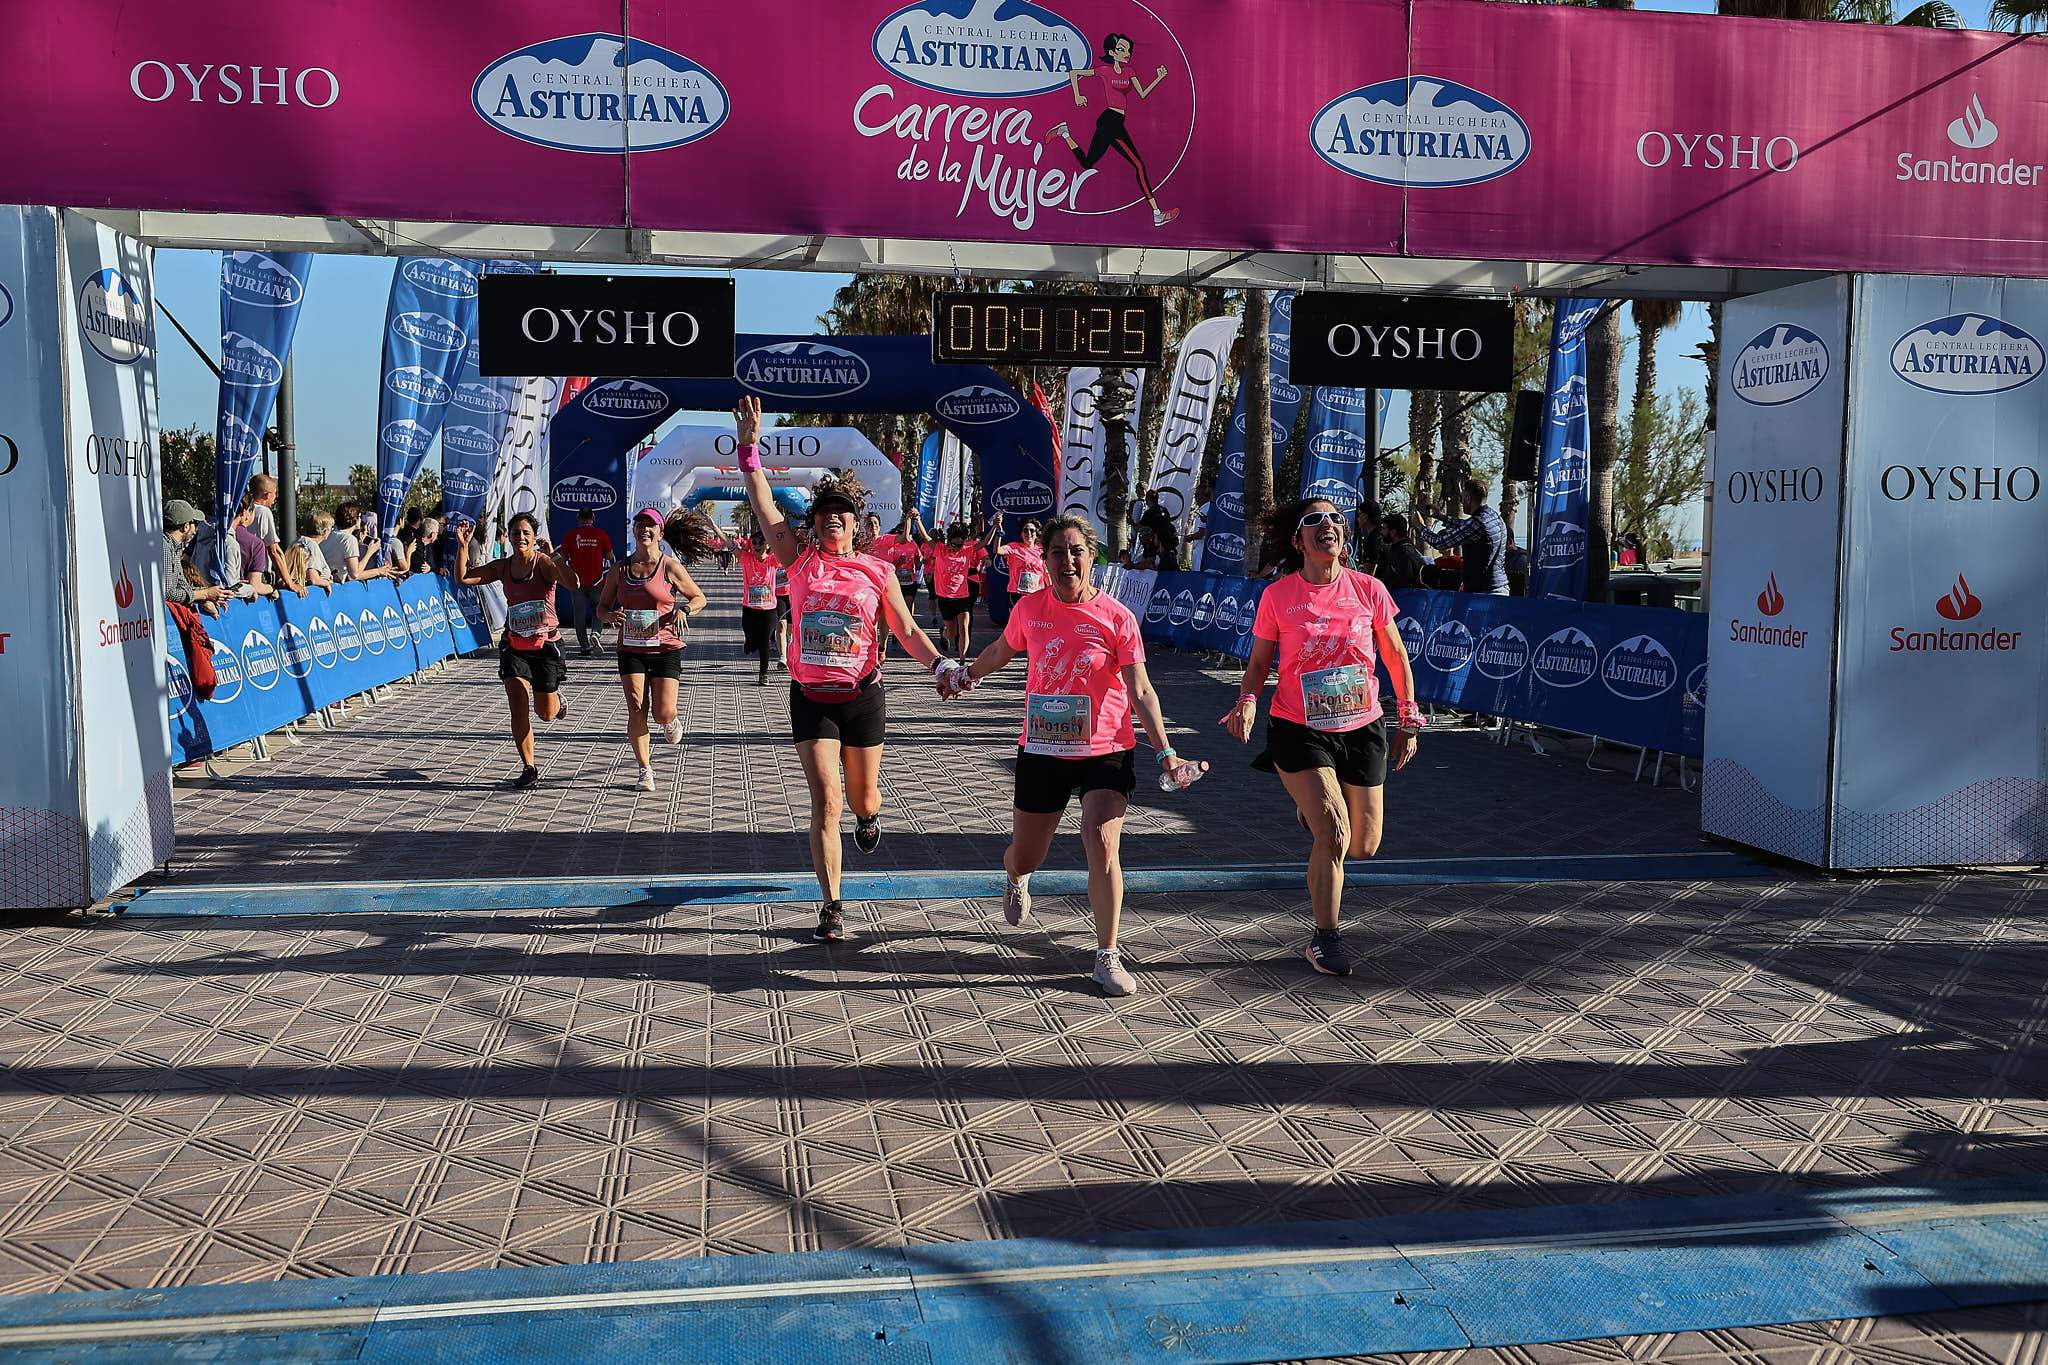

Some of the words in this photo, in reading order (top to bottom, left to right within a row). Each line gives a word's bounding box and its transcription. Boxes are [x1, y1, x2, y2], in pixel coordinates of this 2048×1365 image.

[924, 24, 993, 38] CENTRAL
[999, 26, 1069, 42] LECHERA
[890, 24, 1073, 73] ASTURIANA
[130, 60, 340, 109] OYSHO
[532, 72, 613, 87] CENTRAL
[492, 73, 710, 124] ASTURIANA
[853, 84, 1033, 145] Carrera
[1362, 112, 1431, 125] CENTRAL
[1438, 115, 1507, 129] LECHERA
[1327, 113, 1514, 161] ASTURIANA
[1636, 131, 1799, 173] OYSHO
[1896, 152, 2042, 188] Santander
[897, 143, 931, 181] de
[938, 145, 962, 183] la
[956, 142, 1099, 230] Mujer
[408, 264, 475, 295] ASTURIANA
[85, 294, 145, 346] ASTURIANA
[521, 307, 700, 347] OYSHO
[950, 305, 1145, 354] 00:41:25
[1327, 323, 1483, 361] OYSHO
[1751, 352, 1782, 364] CENTRAL
[1784, 346, 1819, 360] LECHERA
[1926, 341, 1975, 350] CENTRAL
[1979, 342, 2030, 351] LECHERA
[744, 358, 861, 385] ASTURIANA
[765, 357, 809, 365] CENTRAL
[812, 358, 856, 366] LECHERA
[1900, 342, 2033, 375] ASTURIANA
[1737, 359, 1821, 390] ASTURIANA
[587, 395, 663, 409] ASTURIANA
[942, 401, 1015, 415] ASTURIANA
[1321, 388, 1365, 408] ASTURIA
[86, 434, 152, 479] OYSHO
[511, 377, 538, 516] OYSH
[714, 434, 821, 457] OSHO
[650, 458, 683, 466] OYSHO
[850, 457, 882, 466] OYSHO
[442, 479, 485, 493] STURIANA
[554, 488, 613, 504] ASTURIANA
[920, 460, 938, 508] Marlene
[1728, 466, 1823, 504] OYSHO
[1881, 465, 2041, 502] OYSHO
[635, 501, 666, 509] OYSHO
[866, 502, 897, 511] OYSHO
[99, 618, 152, 647] Santander
[1028, 620, 1054, 629] OYSHO
[1730, 619, 1809, 649] Santander
[1889, 627, 2022, 652] Santander
[1478, 643, 1523, 667] ASTURIANA
[1536, 648, 1591, 675] ASTURIANA
[215, 666, 241, 687] URIANA
[1605, 655, 1667, 687] ASTURIANA
